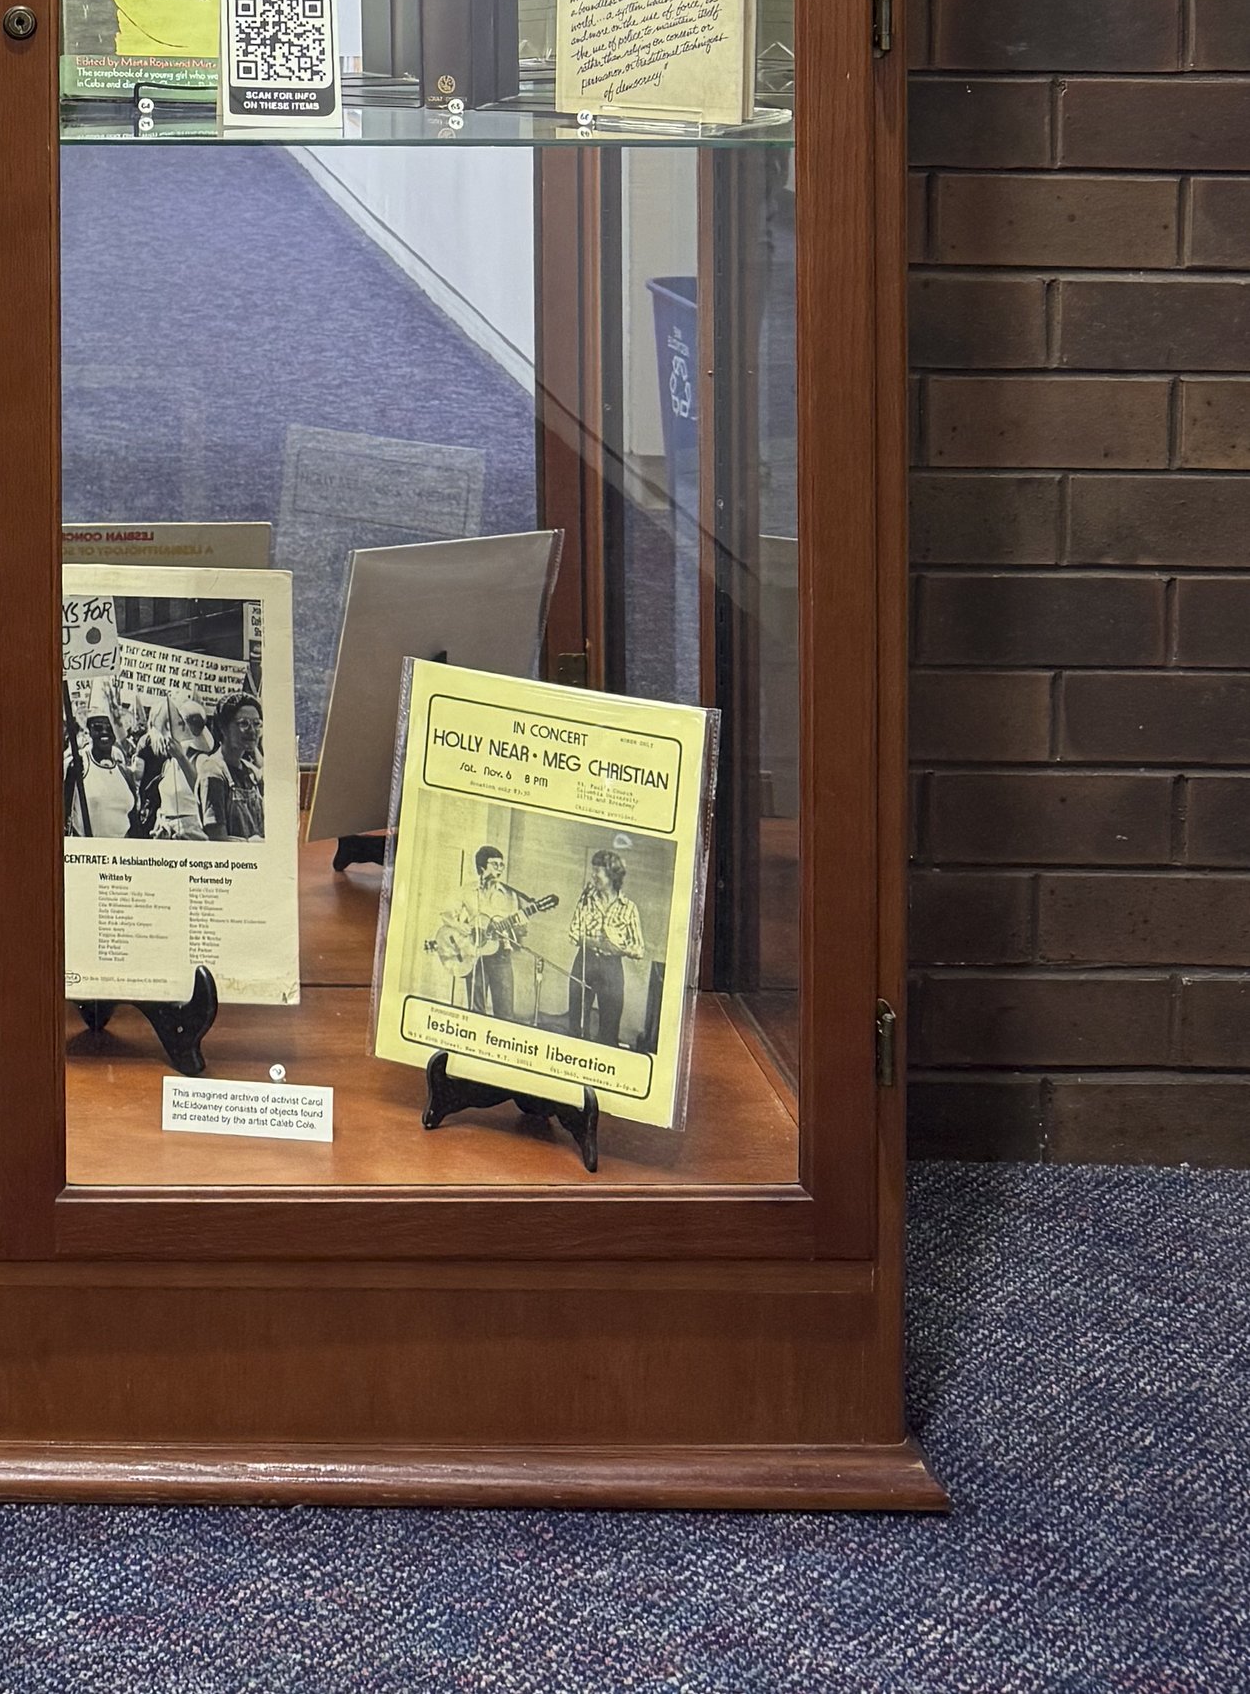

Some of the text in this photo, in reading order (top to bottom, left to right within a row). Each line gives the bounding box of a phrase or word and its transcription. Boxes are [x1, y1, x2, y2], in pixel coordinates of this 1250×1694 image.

[76, 57, 148, 68] Edited by Marta
[77, 68, 92, 77] The
[94, 68, 134, 78] scrapbook
[135, 69, 142, 78] of
[150, 70, 173, 80] young
[176, 70, 188, 80] girl
[190, 70, 205, 80] who
[274, 92, 292, 100] FOR
[294, 92, 316, 100] INFO
[259, 102, 290, 110] THESE
[292, 102, 320, 110] ITEMS
[62, 598, 113, 624] NS FOR
[62, 647, 117, 672] USTICE!
[514, 720, 588, 746] IN CONCERT
[434, 728, 669, 790] HOLLY NEAR MEG CHRISTIAN
[460, 762, 476, 773] Sat.
[484, 766, 503, 778] Nov.
[506, 770, 512, 780] 6
[524, 774, 530, 784] 8
[64, 854, 258, 870] CENTRATE: A lesbianthology of songs and poems
[99, 873, 132, 882] Written by
[190, 876, 232, 886] Performed by
[426, 1015, 616, 1076] lesbian feminist liberation
[173, 1089, 323, 1106] This imagined archive of activist Carol
[172, 1100, 323, 1118] McEldowney consists of objects found
[172, 1112, 316, 1130] and created by the artist Caleb Cole.
